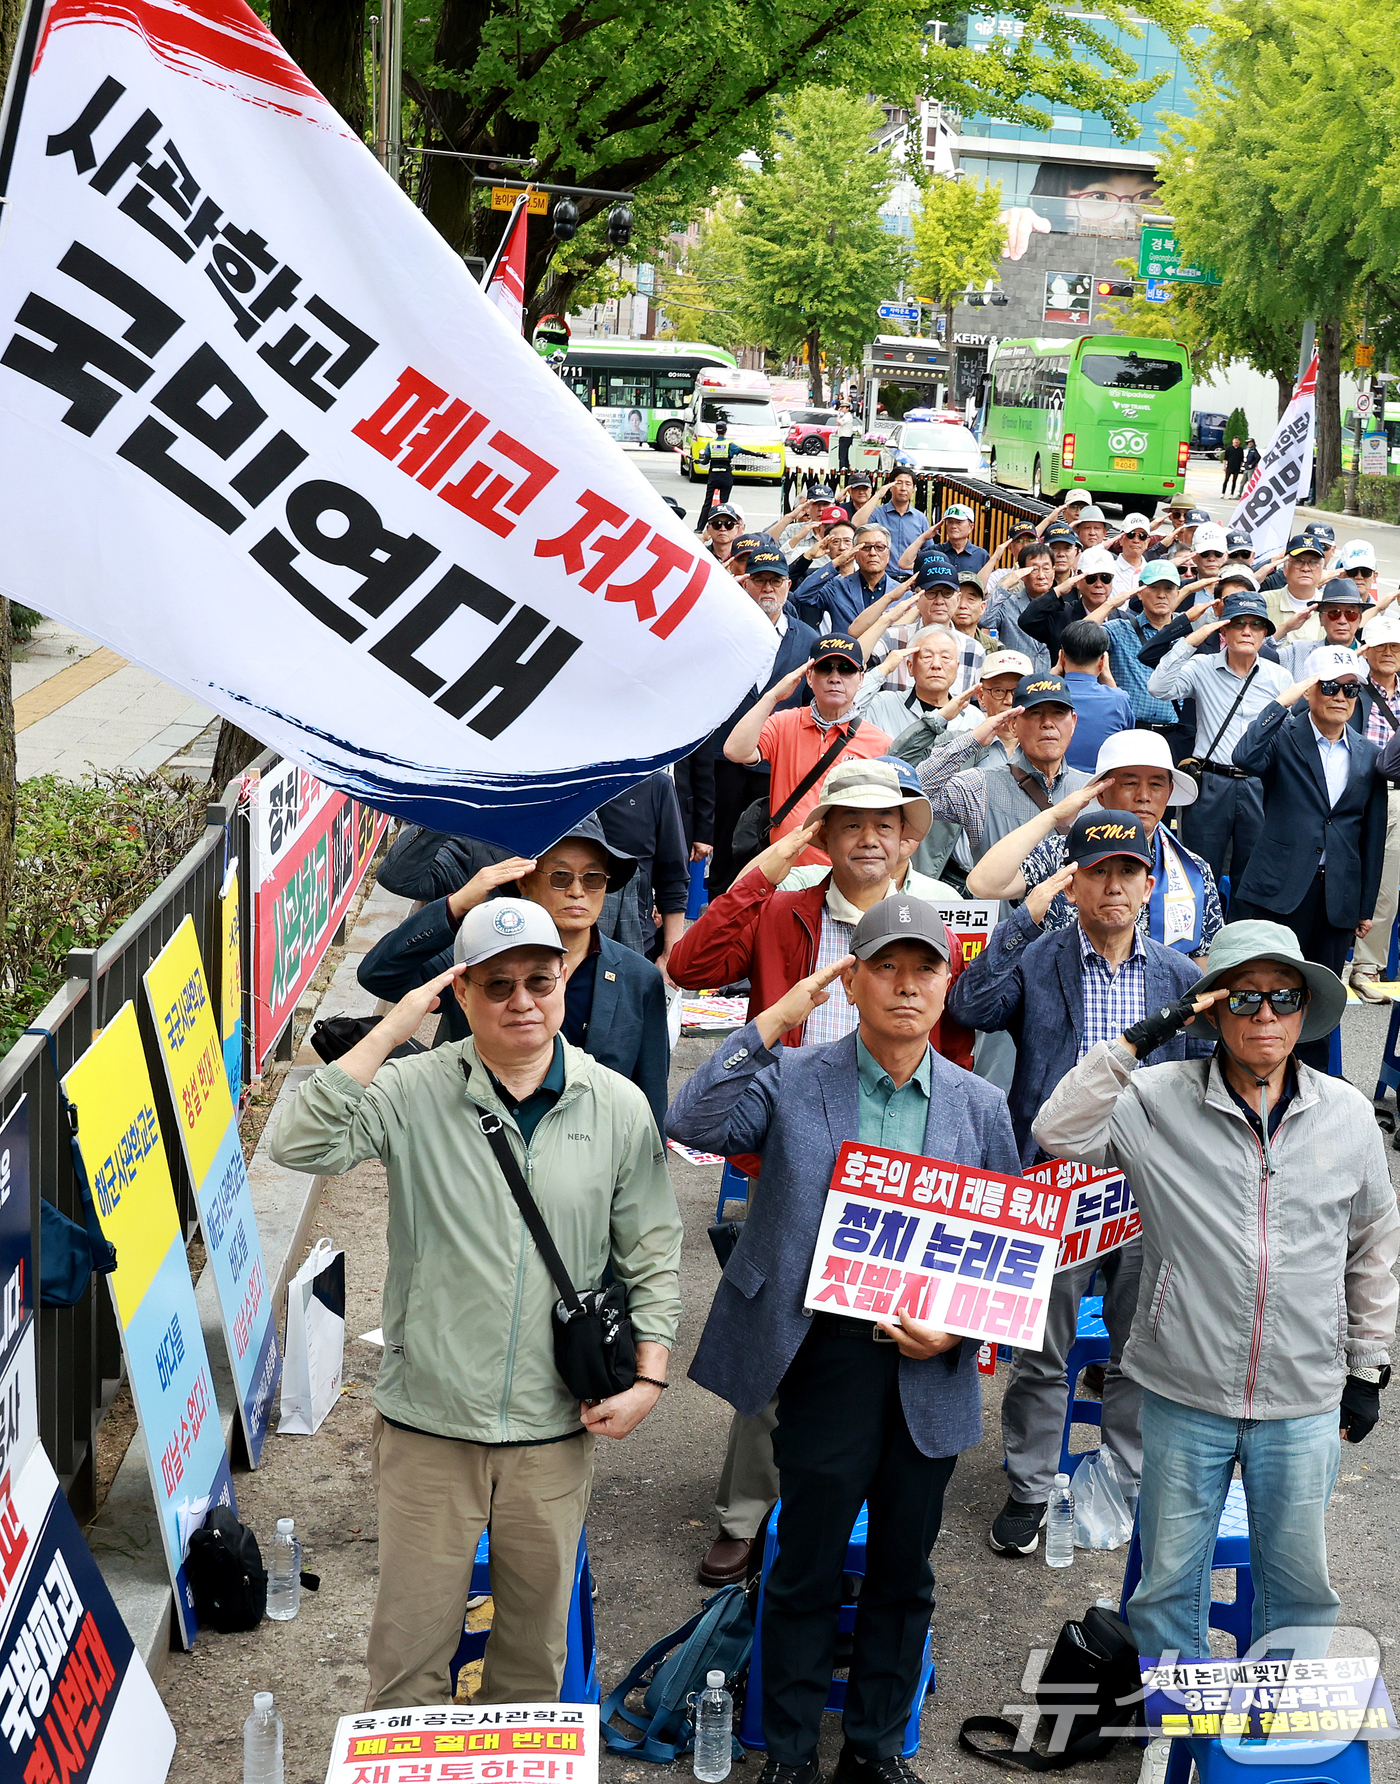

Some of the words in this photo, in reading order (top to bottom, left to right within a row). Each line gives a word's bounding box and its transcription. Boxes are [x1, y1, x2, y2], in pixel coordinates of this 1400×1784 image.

[1151, 238, 1176, 252] 경복
[46, 75, 379, 412] 사관학교
[350, 366, 560, 539] 폐교
[534, 488, 711, 640] 저지
[1121, 390, 1156, 399] Tripadvisor
[0, 240, 583, 741] 국민연대
[736, 539, 761, 549] KMA
[754, 552, 781, 562] KMA
[926, 566, 953, 576] KUFA
[820, 638, 855, 651] KMA
[1026, 680, 1061, 695] KMA
[1085, 823, 1138, 842] KMA
[270, 829, 329, 1018] 사관학교
[164, 966, 206, 1053] 국군사관학교
[182, 1071, 203, 1129] 창설
[567, 1133, 591, 1142] NEPA
[95, 1103, 159, 1218] 해군사관학교는
[1056, 1161, 1088, 1188] 성지
[206, 1149, 246, 1252] 해군사관학교는
[840, 1151, 911, 1198] 호국의
[912, 1166, 960, 1208] 성지
[960, 1176, 1007, 1219] 태릉
[1007, 1186, 1063, 1231] 육사!
[1075, 1179, 1139, 1228] 논리
[228, 1218, 249, 1285] 바다를
[831, 1202, 920, 1262] 정치
[920, 1222, 1045, 1290] 논리로
[1055, 1227, 1092, 1268] 지
[233, 1304, 250, 1361] 떠날
[244, 1291, 254, 1330] 수
[249, 1253, 265, 1318] 없다!
[814, 1255, 941, 1320] 짓밟지
[944, 1282, 1043, 1340] 마라!
[155, 1311, 186, 1393] 바다를
[160, 1430, 185, 1499] 떠날
[179, 1414, 192, 1459] 수
[186, 1366, 211, 1443] 없다!
[0, 1547, 85, 1755] 국방파괴
[1154, 1668, 1189, 1688] 정치
[1194, 1666, 1249, 1686] 논리에
[1294, 1662, 1329, 1682] 호국
[1334, 1658, 1370, 1680] 성지
[1184, 1688, 1231, 1713] 3군
[1242, 1685, 1359, 1711] 사관학교
[352, 1711, 585, 1731] 육·해·공군사관학교
[1259, 1707, 1390, 1734] 철회하라!
[353, 1735, 422, 1756] 폐교
[433, 1732, 501, 1753] 절대
[511, 1731, 578, 1751] 반대
[352, 1759, 574, 1784] 재검토하라!
